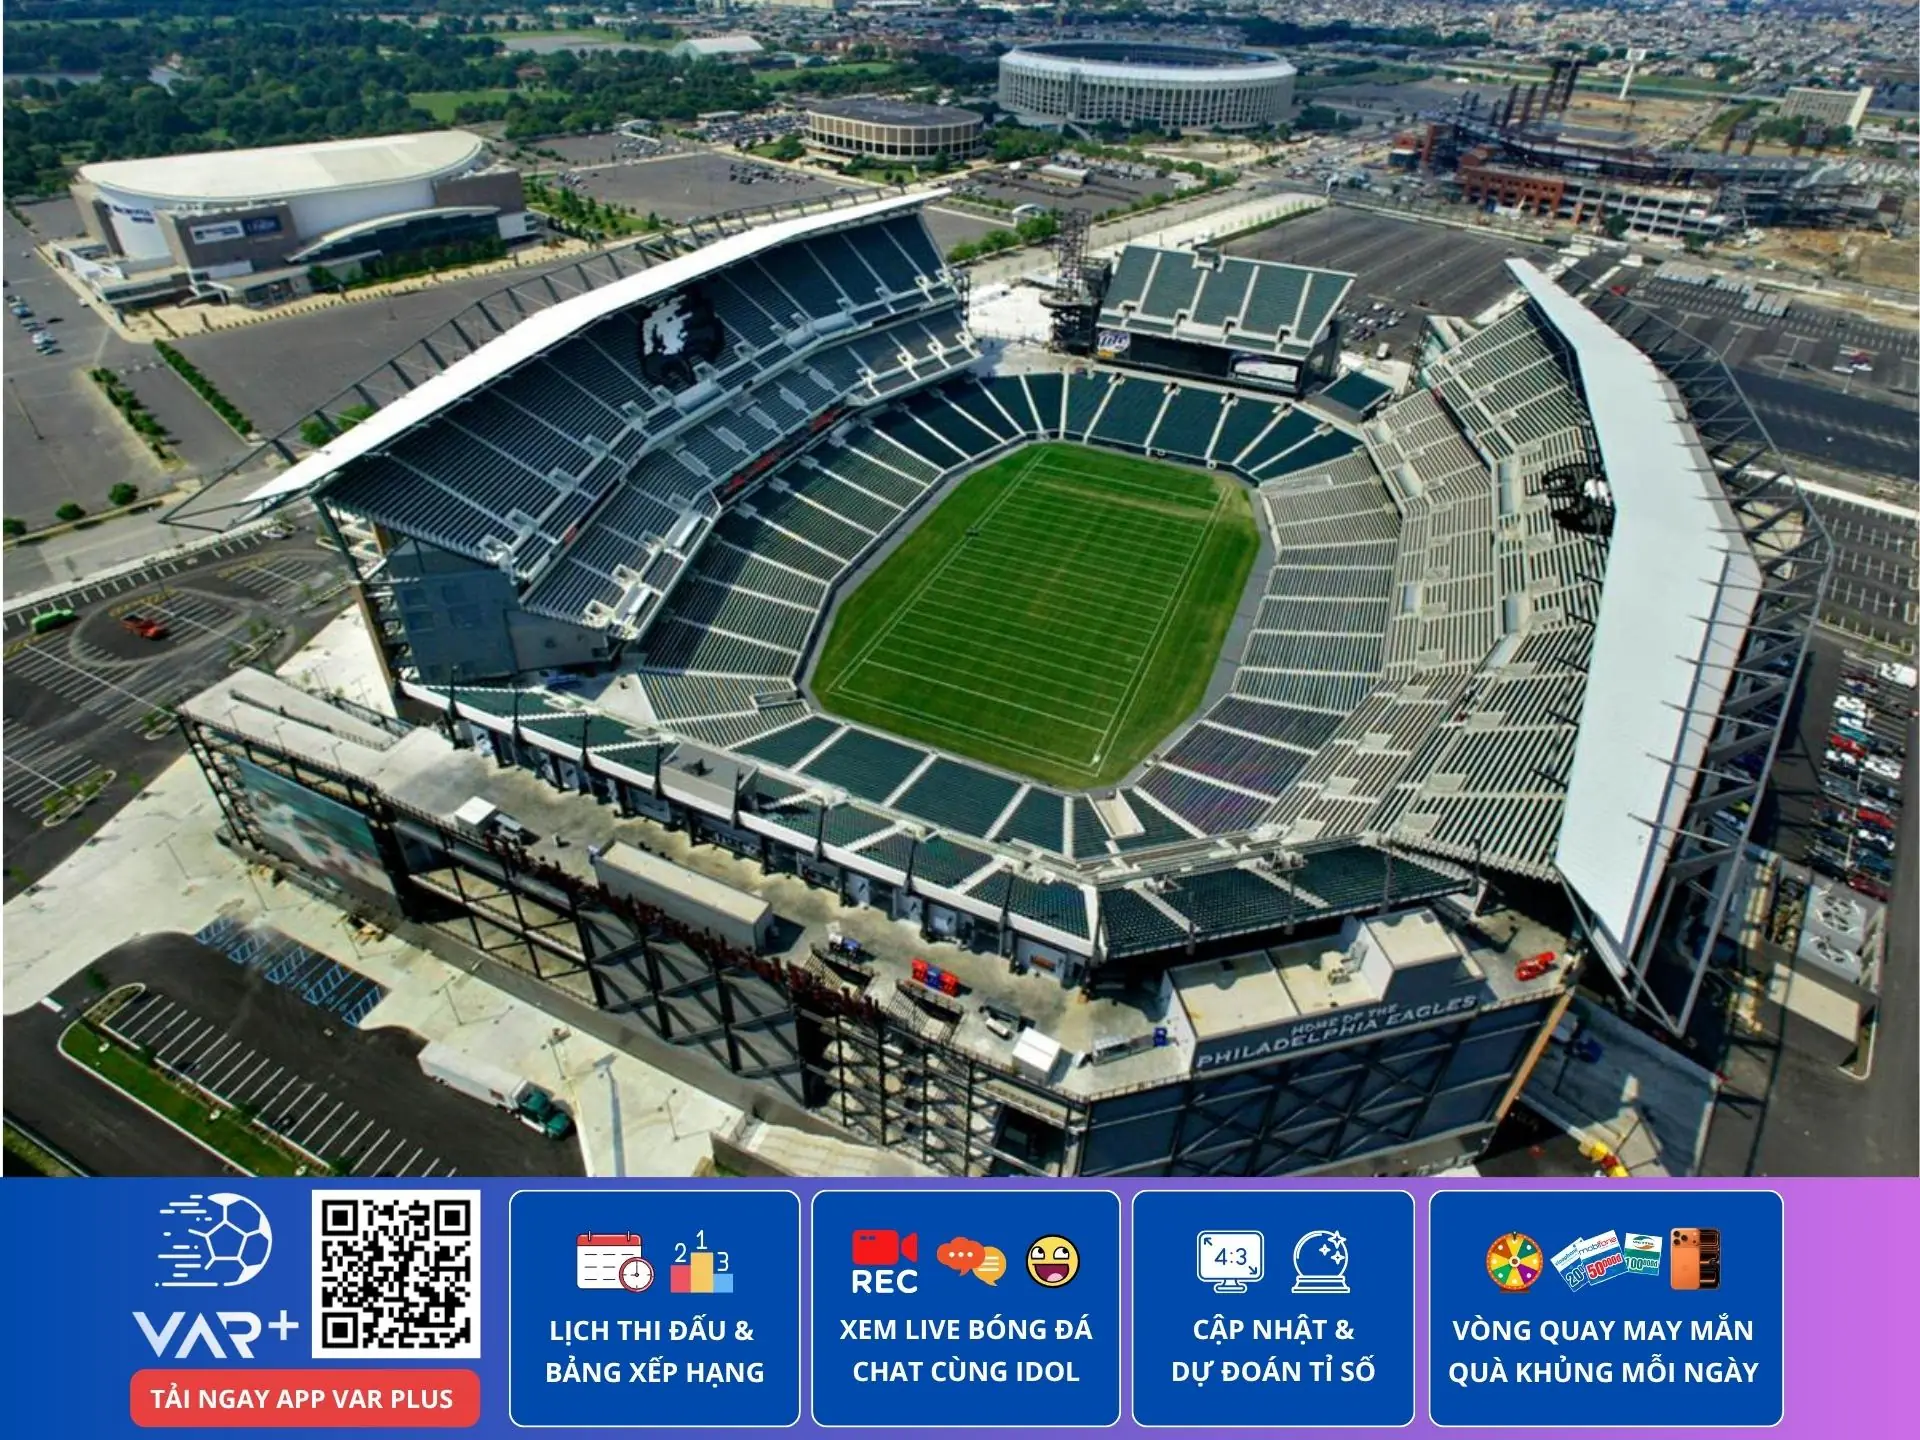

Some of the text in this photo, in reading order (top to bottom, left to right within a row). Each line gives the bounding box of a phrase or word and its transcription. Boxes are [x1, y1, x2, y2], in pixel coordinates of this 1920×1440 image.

[1196, 995, 1476, 1068] PHILADELPHIA EAGLES
[1291, 1003, 1398, 1035] HOME OF THE
